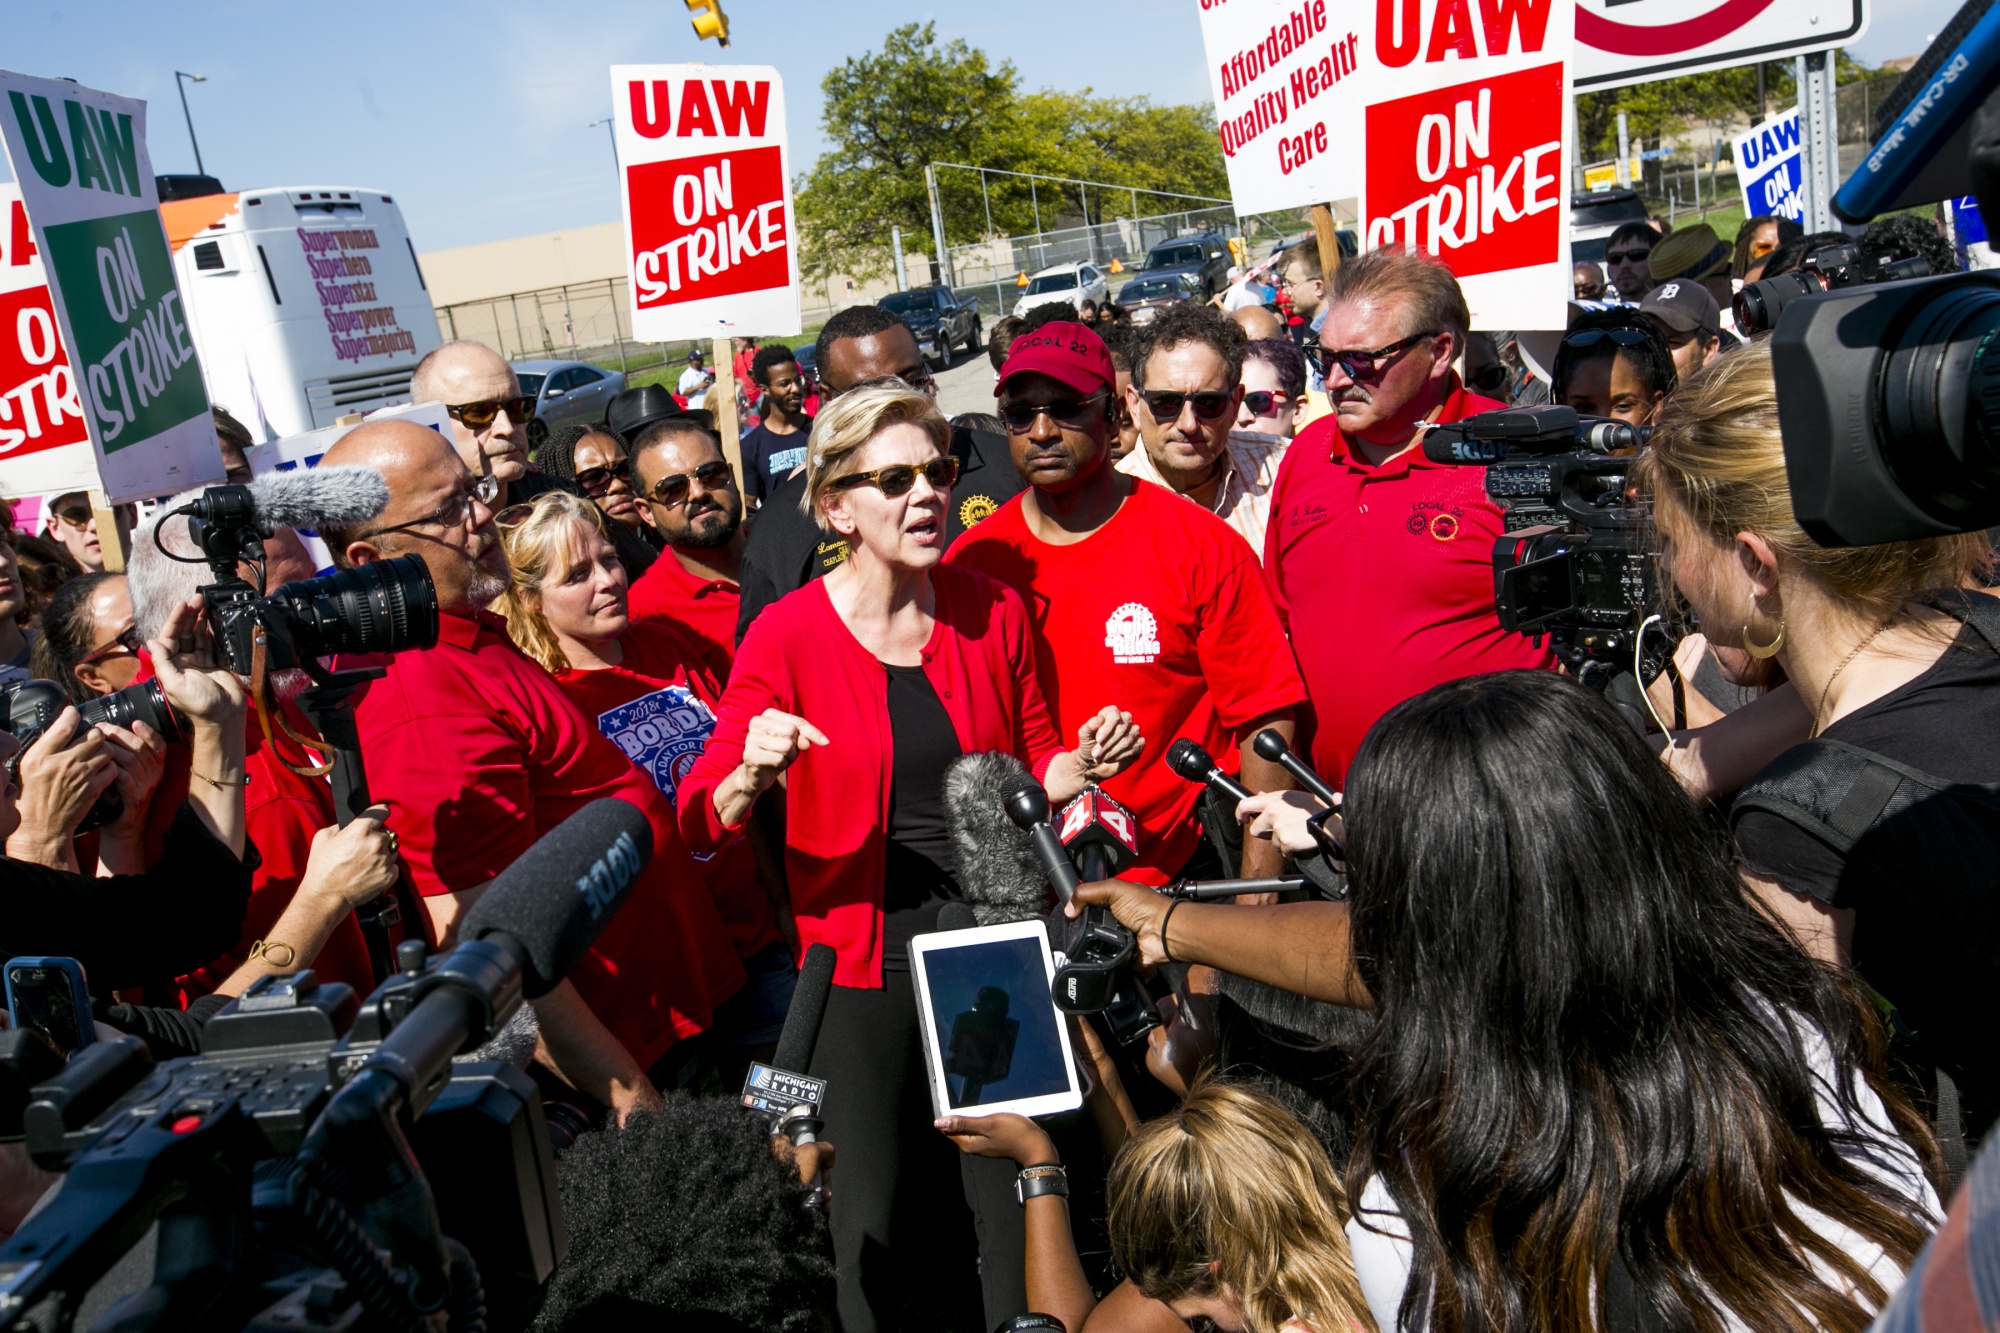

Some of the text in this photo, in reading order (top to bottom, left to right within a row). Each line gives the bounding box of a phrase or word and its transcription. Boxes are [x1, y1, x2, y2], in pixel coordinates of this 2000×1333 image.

[1221, 0, 1327, 101] Affordable
[1375, 0, 1552, 68] UAW
[628, 80, 771, 139] UAW
[1220, 31, 1358, 158] Quality Health
[8, 90, 142, 198] UAW
[1278, 121, 1328, 176] Care
[1416, 87, 1491, 183] ON
[1741, 114, 1800, 169] UAW
[673, 158, 733, 226] ON
[1765, 163, 1791, 208] ON
[297, 227, 380, 257] Superwoman
[635, 200, 786, 303] STRIKE
[96, 226, 146, 323] ON
[306, 251, 372, 283] Superhero
[315, 280, 378, 310] Superstar
[17, 307, 64, 365] O
[324, 306, 397, 337] Superpower
[88, 290, 193, 442] STRIKE
[332, 327, 416, 363] Supermajority
[1070, 340, 1087, 356] 22
[0, 364, 83, 453] STR
[1412, 502, 1465, 519] LOCAL 22
[629, 700, 657, 722] 2018
[616, 714, 682, 760] BOR
[658, 749, 674, 768] DAY
[672, 741, 697, 754] FOR
[1060, 800, 1091, 839] 4
[1101, 811, 1133, 842] 4
[745, 1096, 767, 1107] npr
[772, 1082, 816, 1100] RADIO
[774, 1074, 817, 1092] MICHIGAN
